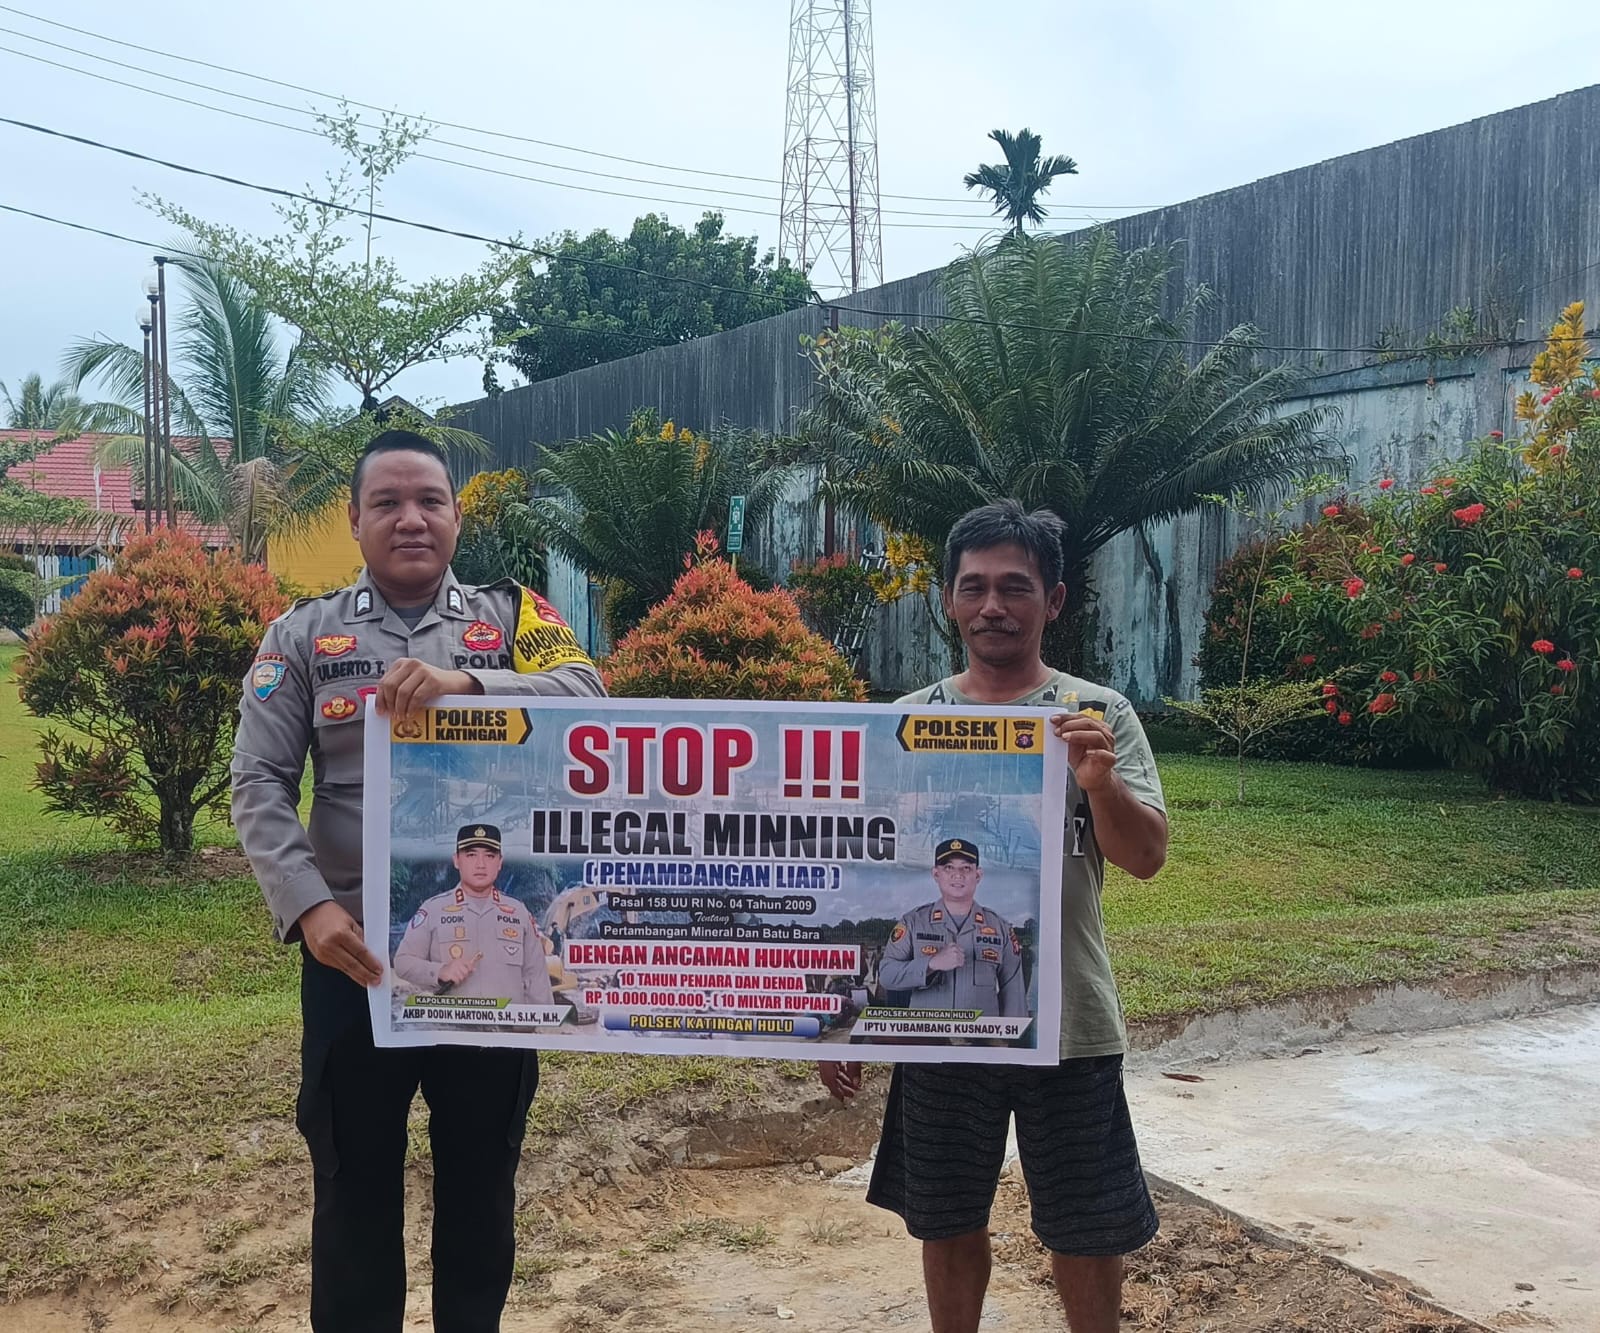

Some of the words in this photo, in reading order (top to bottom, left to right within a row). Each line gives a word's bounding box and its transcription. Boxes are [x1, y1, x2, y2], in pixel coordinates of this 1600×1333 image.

[454, 654, 511, 669] POLR
[316, 661, 371, 682] ULBERTO
[375, 661, 385, 675] T.
[435, 709, 508, 727] POLRES
[435, 728, 507, 741] KATINGAN
[914, 718, 998, 738] POLSEK
[914, 737, 968, 750] KATINGAN
[969, 738, 998, 751] HULU
[567, 725, 754, 796] STOP
[783, 728, 861, 800] !!!
[531, 810, 692, 855] ILLEGAL
[703, 812, 896, 861] MINNING
[612, 896, 644, 908] Pasal
[647, 897, 668, 908] 158
[671, 898, 688, 908] UU
[691, 898, 704, 909] RI
[707, 898, 726, 909] No.
[729, 898, 742, 909] 04
[748, 898, 782, 910] Tahun
[785, 900, 812, 911] 2009
[441, 915, 465, 924] DODIK
[694, 911, 730, 925] Tentang
[604, 925, 688, 939] Pertambangan
[691, 926, 733, 938] Mineral
[736, 927, 759, 939] Dan
[762, 928, 790, 940] Batu
[793, 929, 820, 940] Bara
[569, 944, 648, 966] DENGAN
[652, 946, 750, 968] ANCAMAN
[754, 948, 856, 970] HUKUMAN
[620, 972, 635, 986] 10
[637, 973, 677, 988] TAHUN
[680, 974, 732, 989] PENJARA
[735, 975, 760, 990] DAN
[763, 977, 804, 991] DENDA
[416, 997, 456, 1005] KAPOLRES
[457, 998, 497, 1006] KATINGAN
[585, 991, 603, 1005] RP.
[738, 995, 782, 1010] MILYAR
[403, 1008, 426, 1020] AKBP
[427, 1009, 453, 1020] DODIK
[454, 1010, 496, 1022] HARTONO,
[498, 1011, 516, 1023] S.H.,
[542, 1012, 561, 1023] M.H.
[866, 1009, 909, 1018] KAPOLSEK
[910, 1010, 951, 1019] KATINGAN
[952, 1011, 975, 1020] HULU
[630, 1014, 682, 1029] POLSEK
[686, 1016, 753, 1032] KATINGAN
[757, 1018, 793, 1033] HULU
[864, 1022, 887, 1033] IPTU
[889, 1022, 952, 1034] YUBAMBANG
[954, 1023, 1003, 1036] KUSNADY,
[1005, 1025, 1019, 1035] SH
